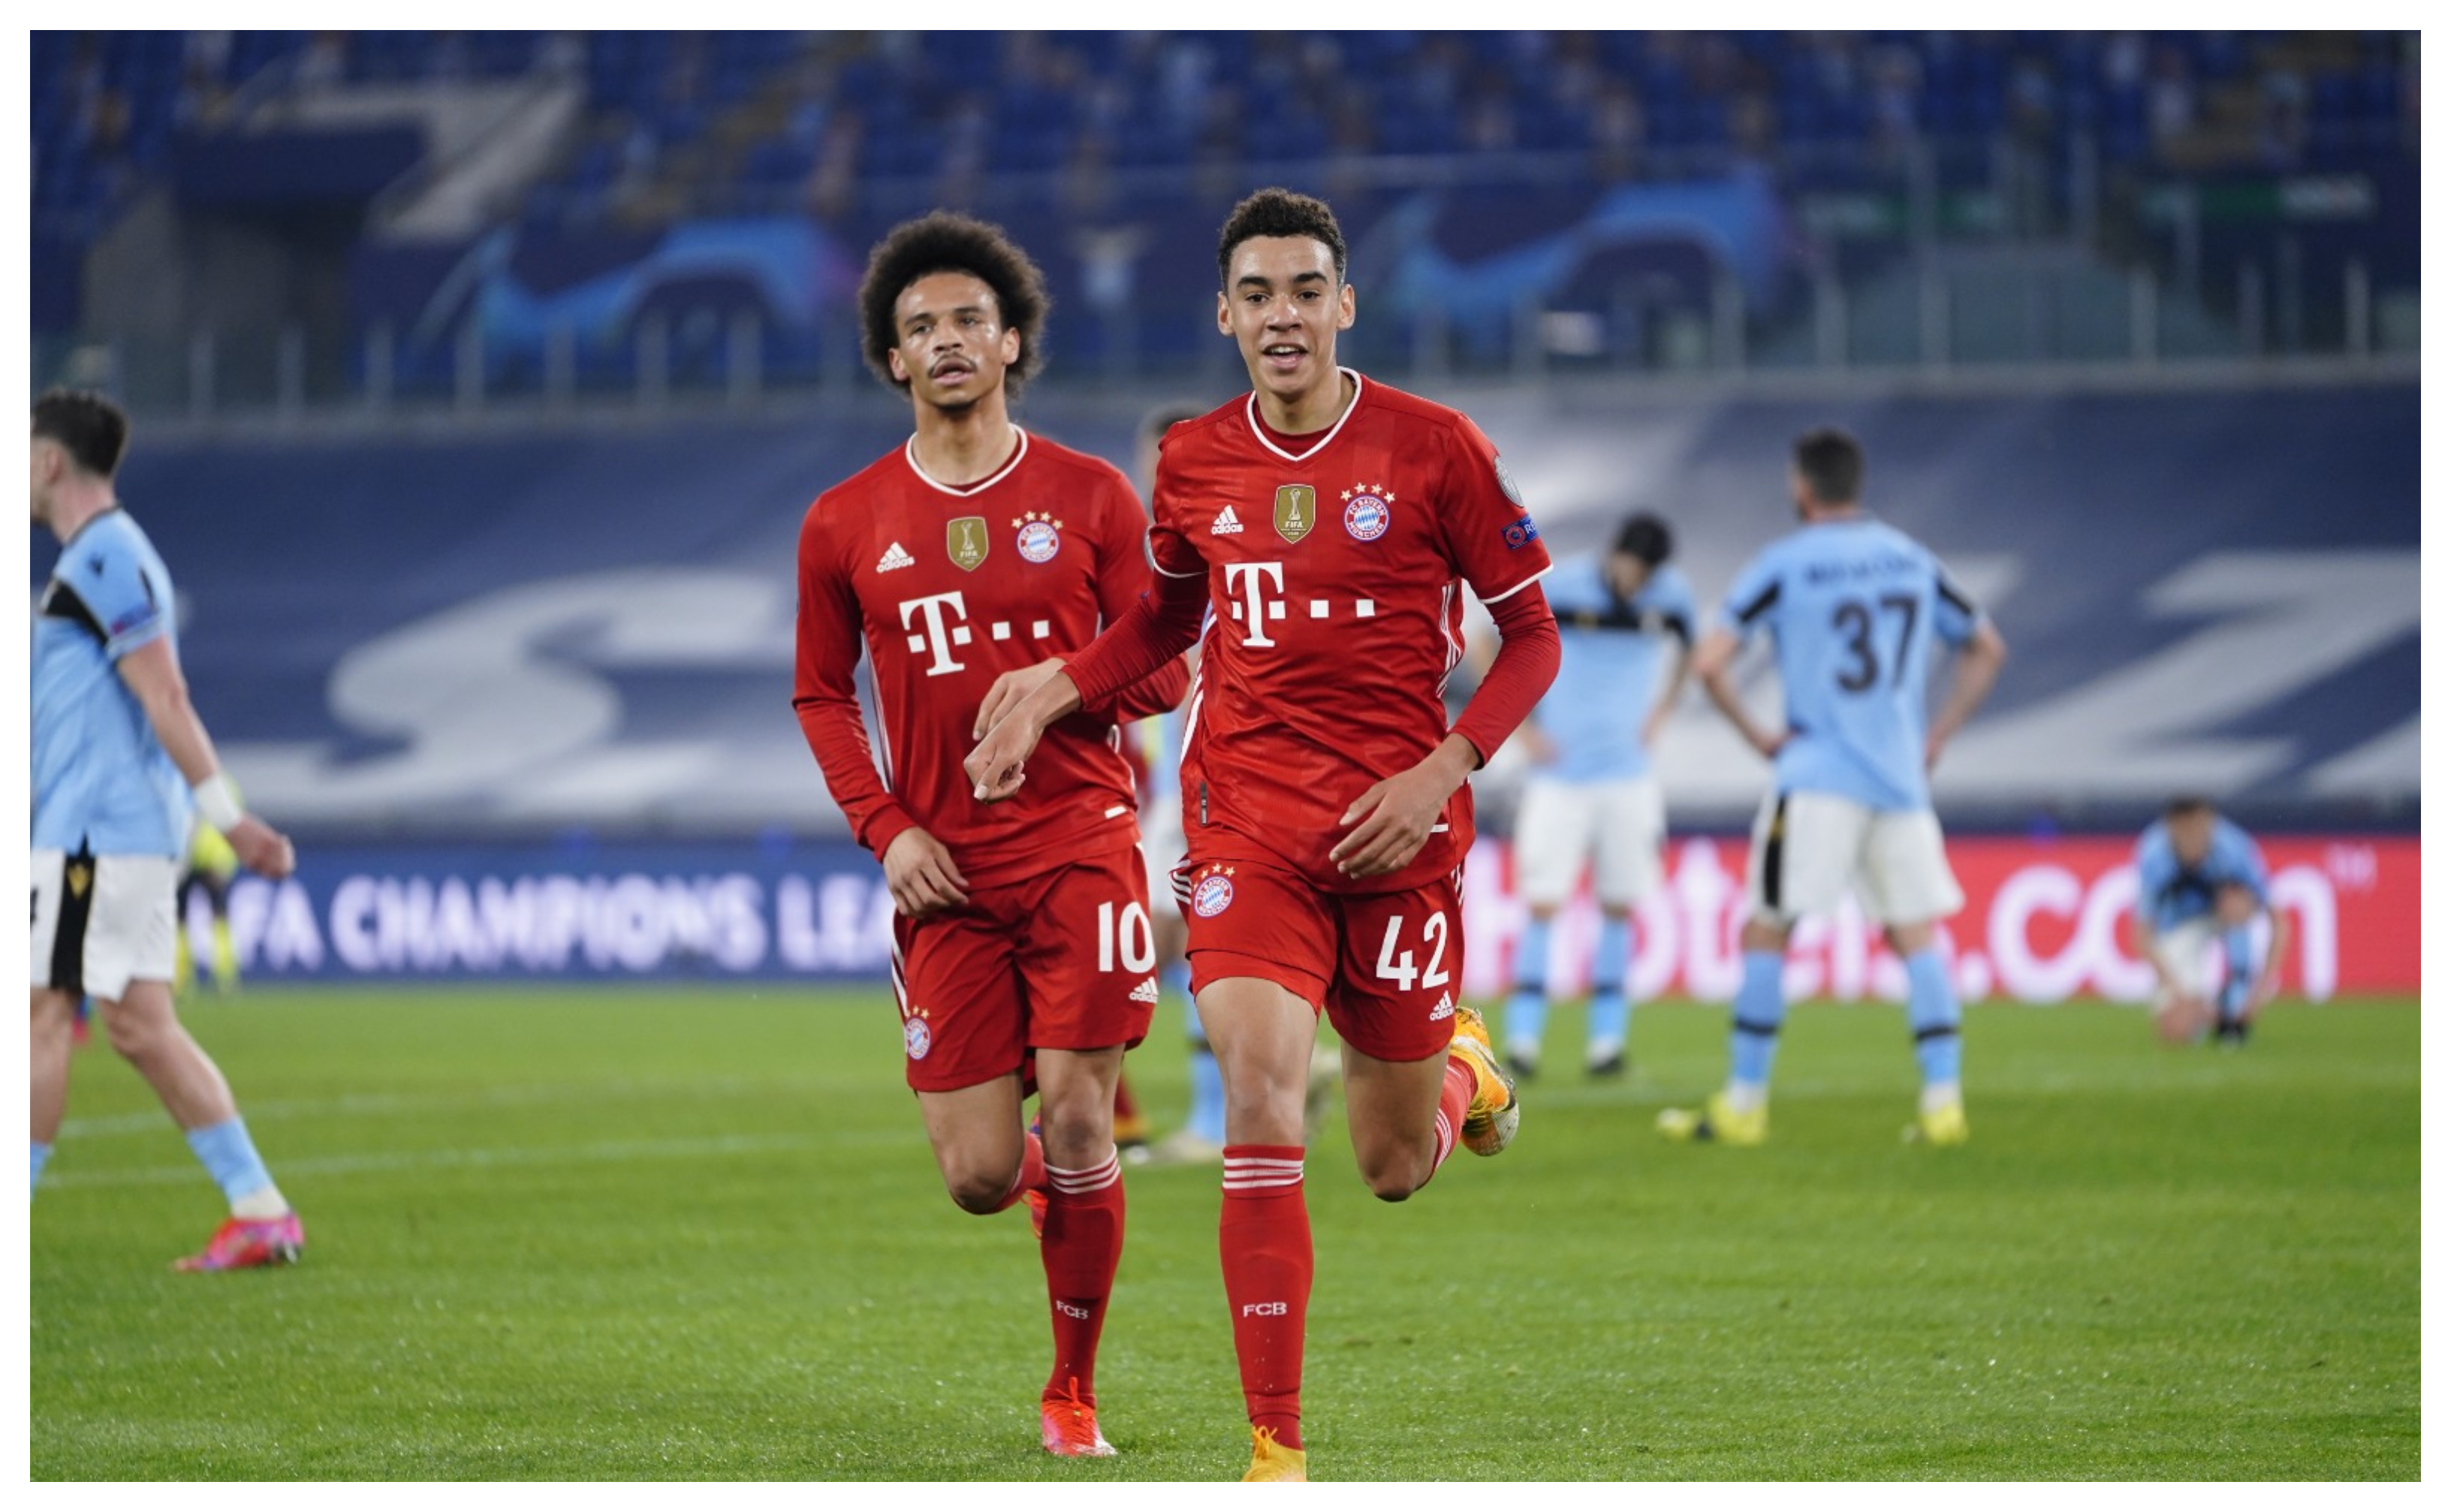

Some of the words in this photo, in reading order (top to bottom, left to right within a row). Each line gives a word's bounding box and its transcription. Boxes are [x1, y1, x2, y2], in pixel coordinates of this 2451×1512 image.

[1210, 523, 1244, 535] adidas
[959, 550, 978, 558] FIFA
[876, 556, 915, 573] adidas
[1831, 593, 1919, 694] 37
[329, 875, 767, 971] CHAMPIONS
[1098, 901, 1156, 974] 10
[1376, 911, 1449, 991] 42
[1056, 1300, 1088, 1320] FCB
[1243, 1302, 1288, 1318] FCB
